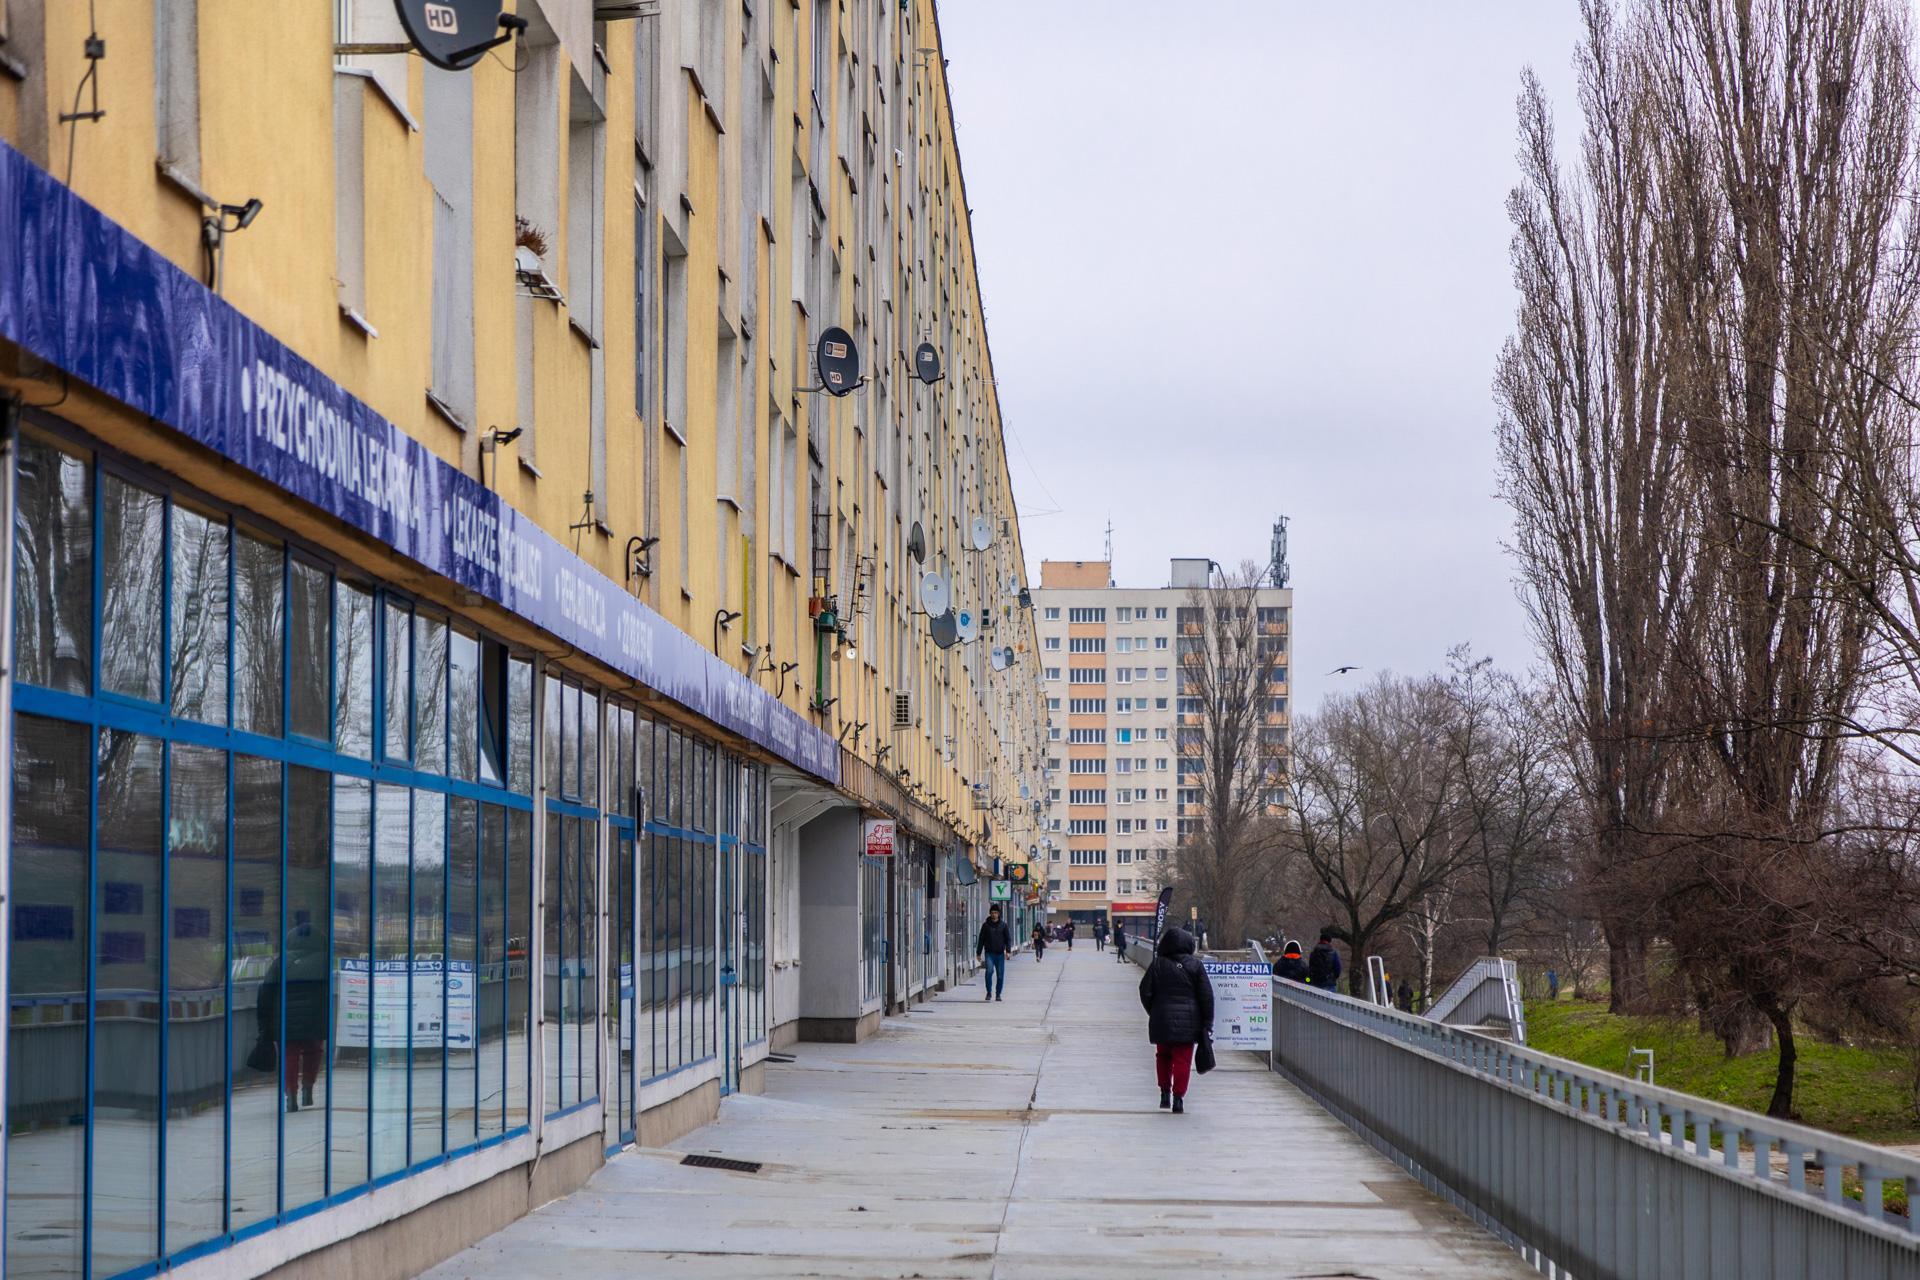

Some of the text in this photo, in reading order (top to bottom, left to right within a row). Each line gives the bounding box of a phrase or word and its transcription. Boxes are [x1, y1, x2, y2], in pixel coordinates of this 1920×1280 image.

[428, 9, 454, 28] HD
[831, 373, 841, 382] HD
[256, 358, 361, 497] PRZYCHODNIA
[362, 437, 420, 529] LEKARSKA
[453, 492, 497, 575] LEKARZE
[1204, 964, 1269, 974] EZPIECZENIA
